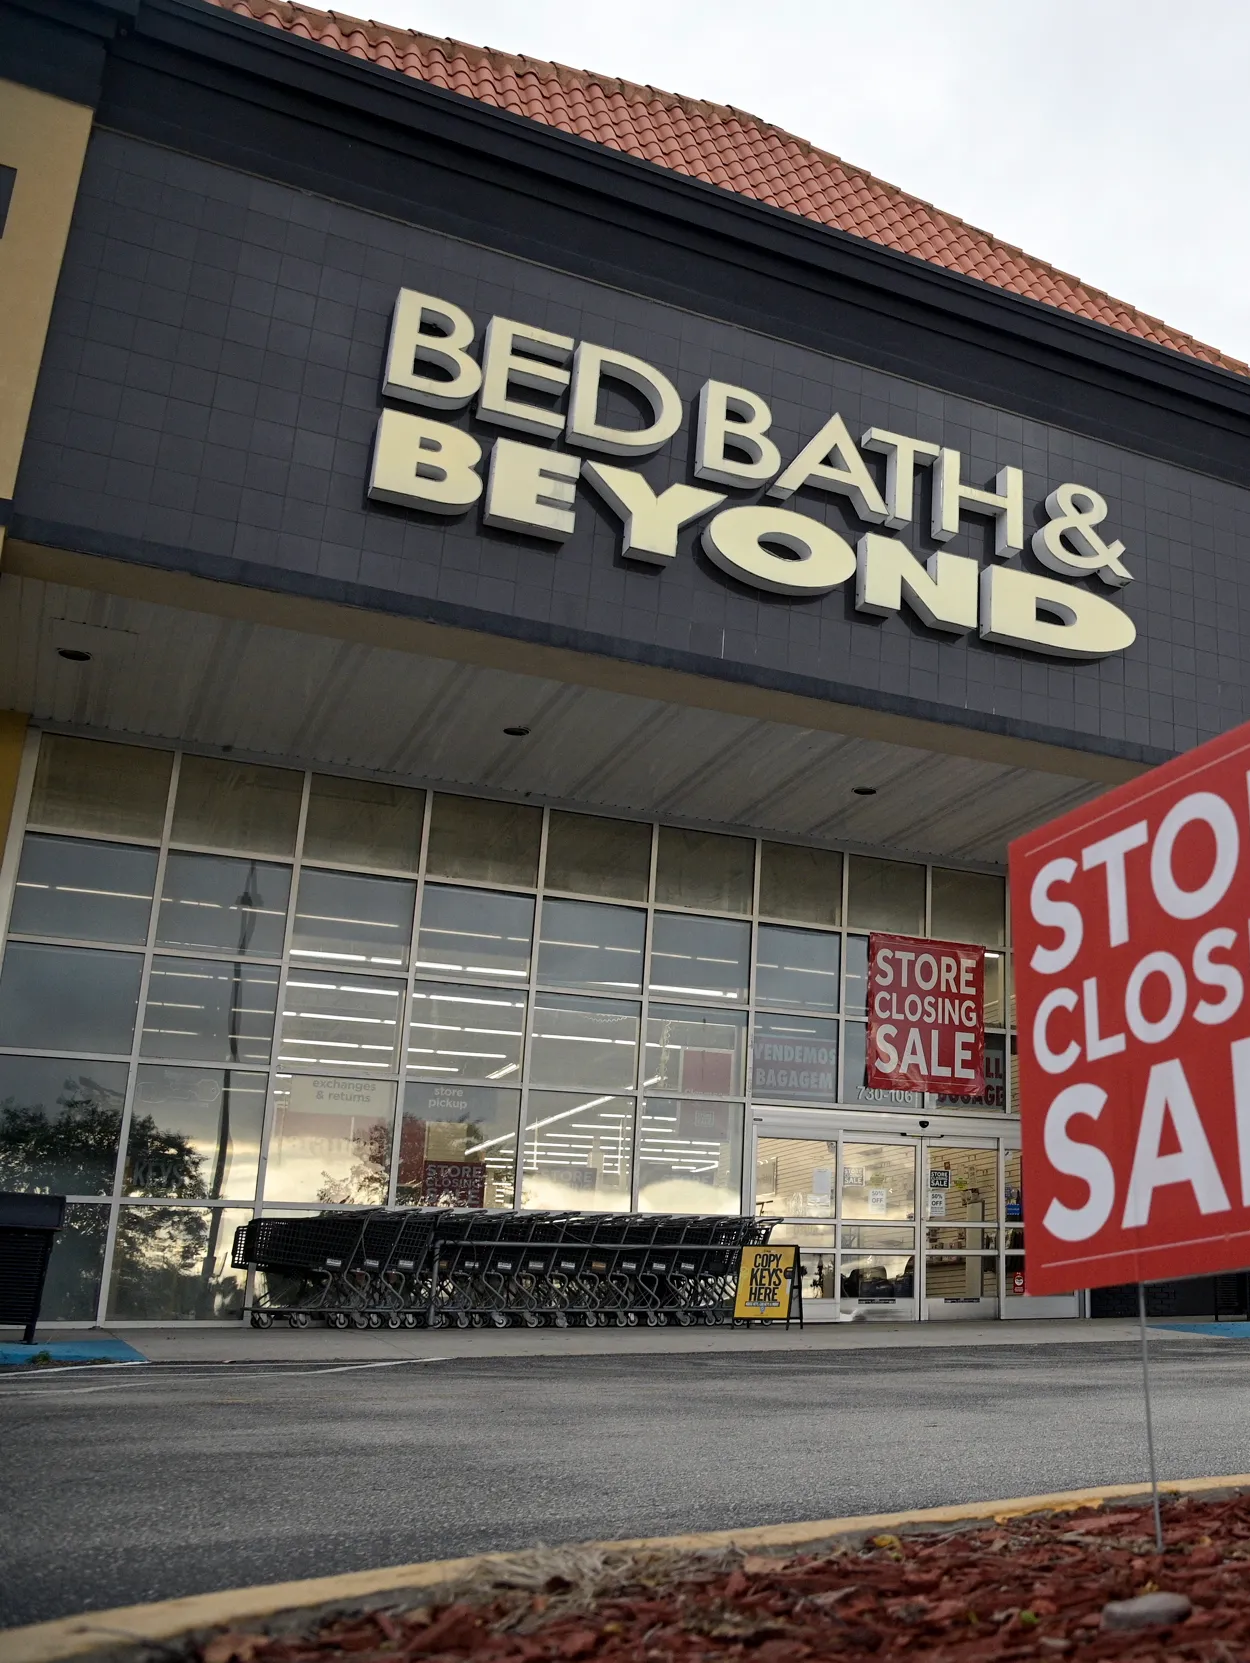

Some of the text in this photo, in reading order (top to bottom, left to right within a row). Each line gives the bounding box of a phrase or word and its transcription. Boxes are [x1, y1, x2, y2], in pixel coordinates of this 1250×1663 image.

[382, 287, 1135, 588] BED BATH &
[367, 409, 1137, 659] BEYOND
[874, 948, 977, 996] STORE
[874, 990, 977, 1028] CLOSING
[754, 1043, 836, 1066] VENDEMOS
[874, 1024, 975, 1080] SALE
[312, 1079, 377, 1092] exchanges
[755, 1067, 833, 1090] BAGAGEM
[315, 1090, 371, 1103] & returns
[434, 1086, 464, 1098] store
[428, 1098, 468, 1110] pickup
[426, 1164, 482, 1178] STORE
[426, 1177, 482, 1188] CLOSING
[754, 1253, 782, 1268] COPY
[749, 1267, 783, 1287] KEYS
[748, 1286, 780, 1302] HERE
